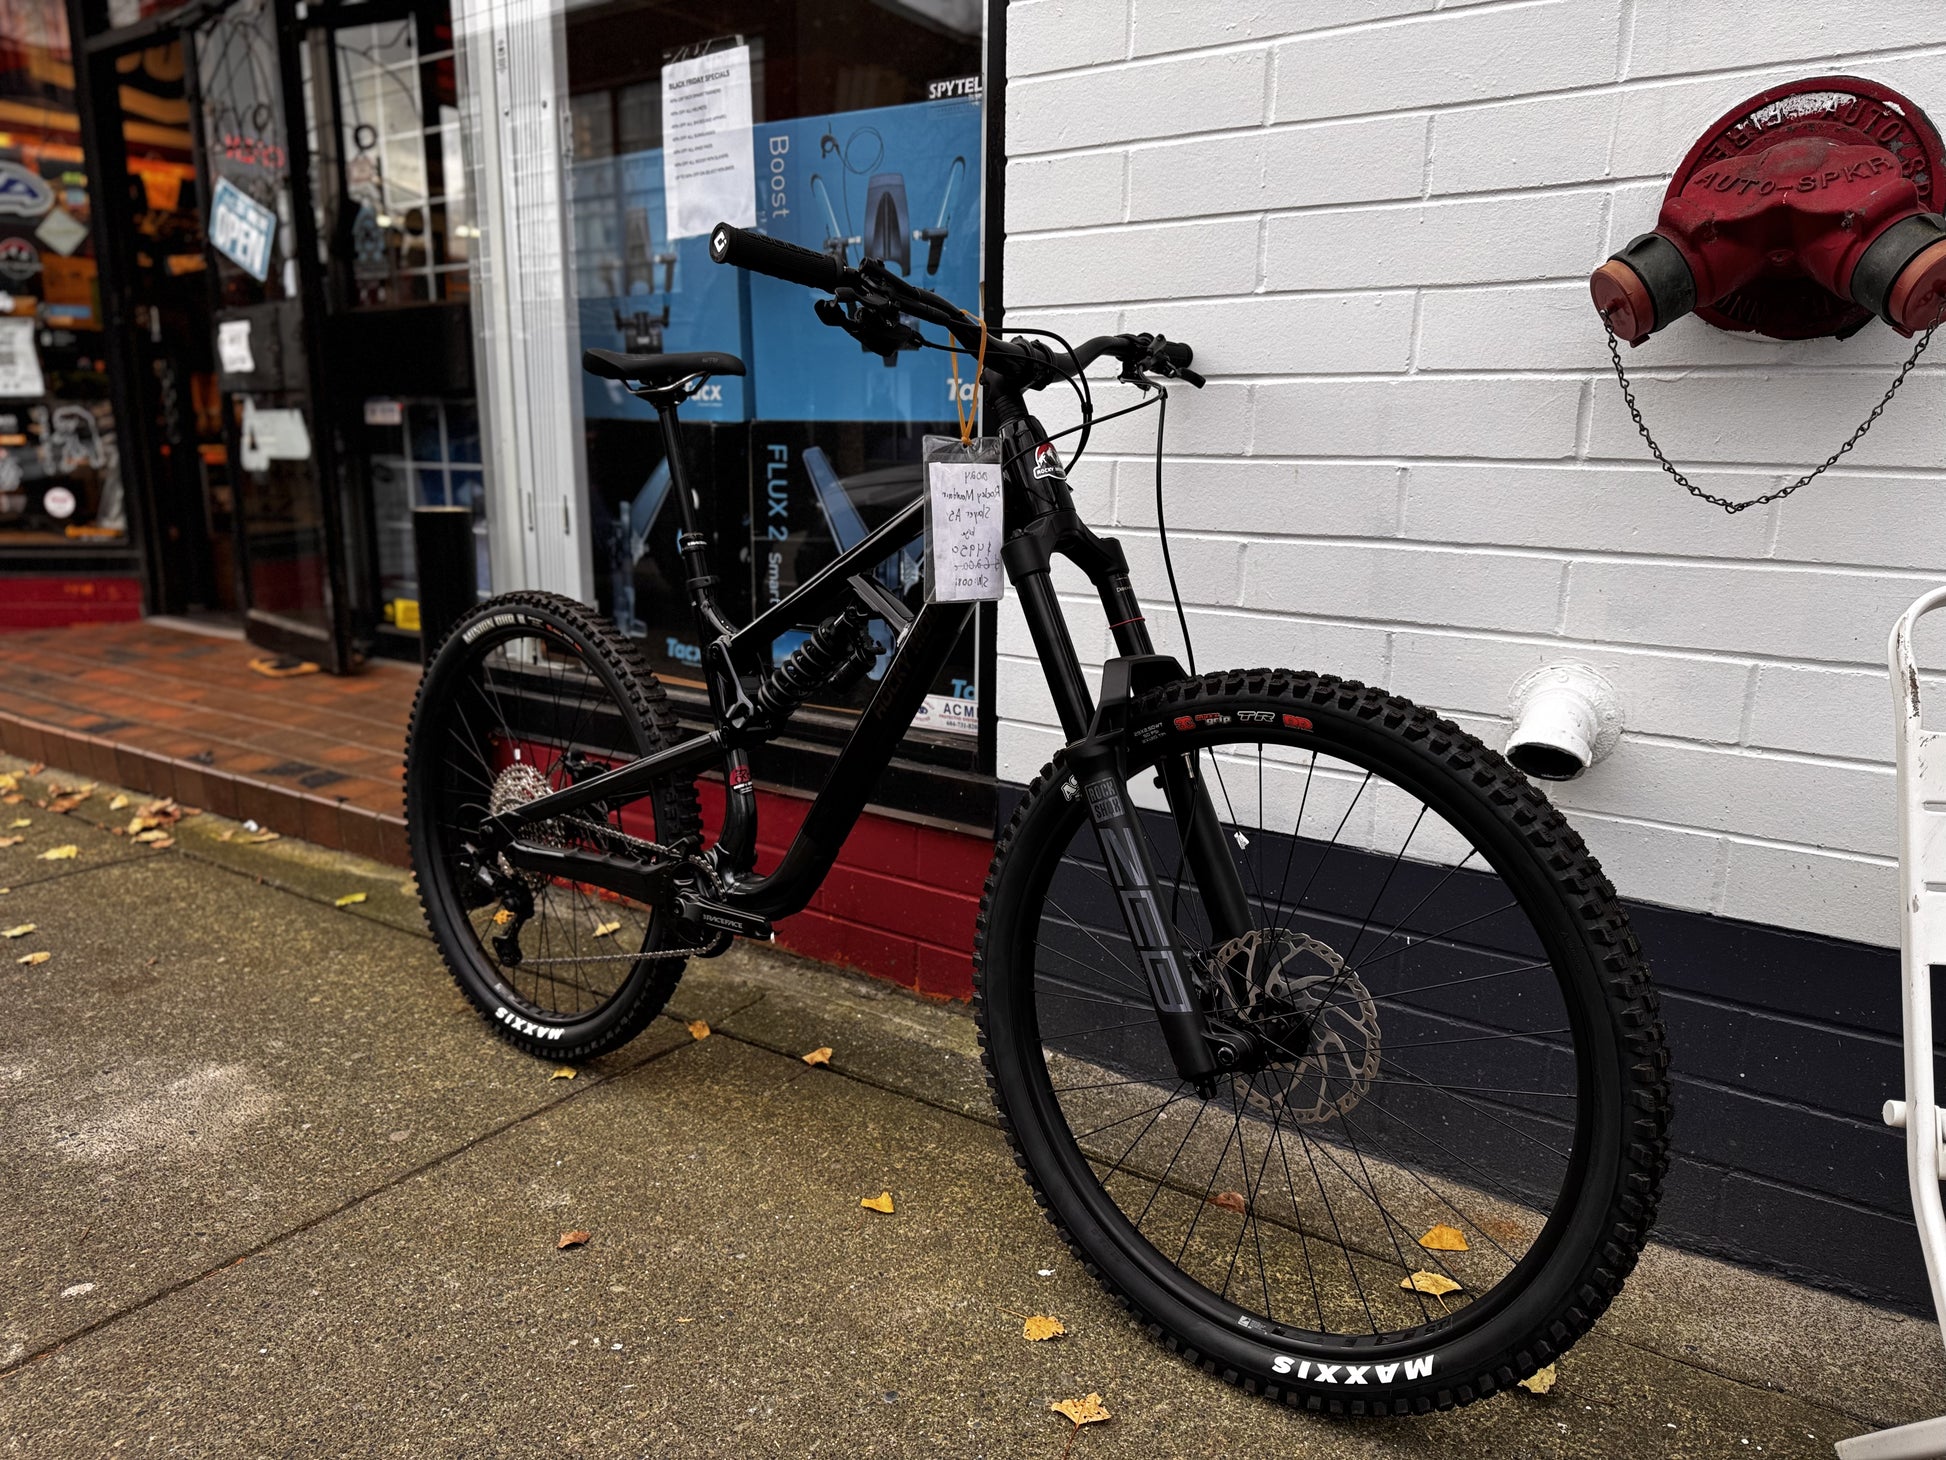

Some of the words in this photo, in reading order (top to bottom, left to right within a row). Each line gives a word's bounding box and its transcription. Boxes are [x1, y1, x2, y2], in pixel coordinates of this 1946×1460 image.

[668, 80, 686, 90] BLACK
[686, 75, 705, 87] FRIDAY
[705, 69, 730, 82] SPECIALS
[929, 76, 983, 99] SPYTEL
[769, 135, 790, 219] Boost
[1693, 156, 1894, 197] AUTO-SPKR
[215, 203, 266, 273] OPEN
[767, 444, 788, 518] FLUX
[768, 526, 789, 542] 2
[768, 552, 783, 603] Smart
[462, 617, 496, 645] MINION
[943, 702, 979, 719] ACM
[1206, 715, 1232, 726] grip
[1237, 711, 1275, 722] TR
[1088, 780, 1116, 803] ROCK
[1094, 798, 1122, 819] SHOX
[706, 914, 743, 929] RACEFACE
[495, 1007, 565, 1040] MAXXIS
[1271, 1354, 1434, 1385] MAXXIS
